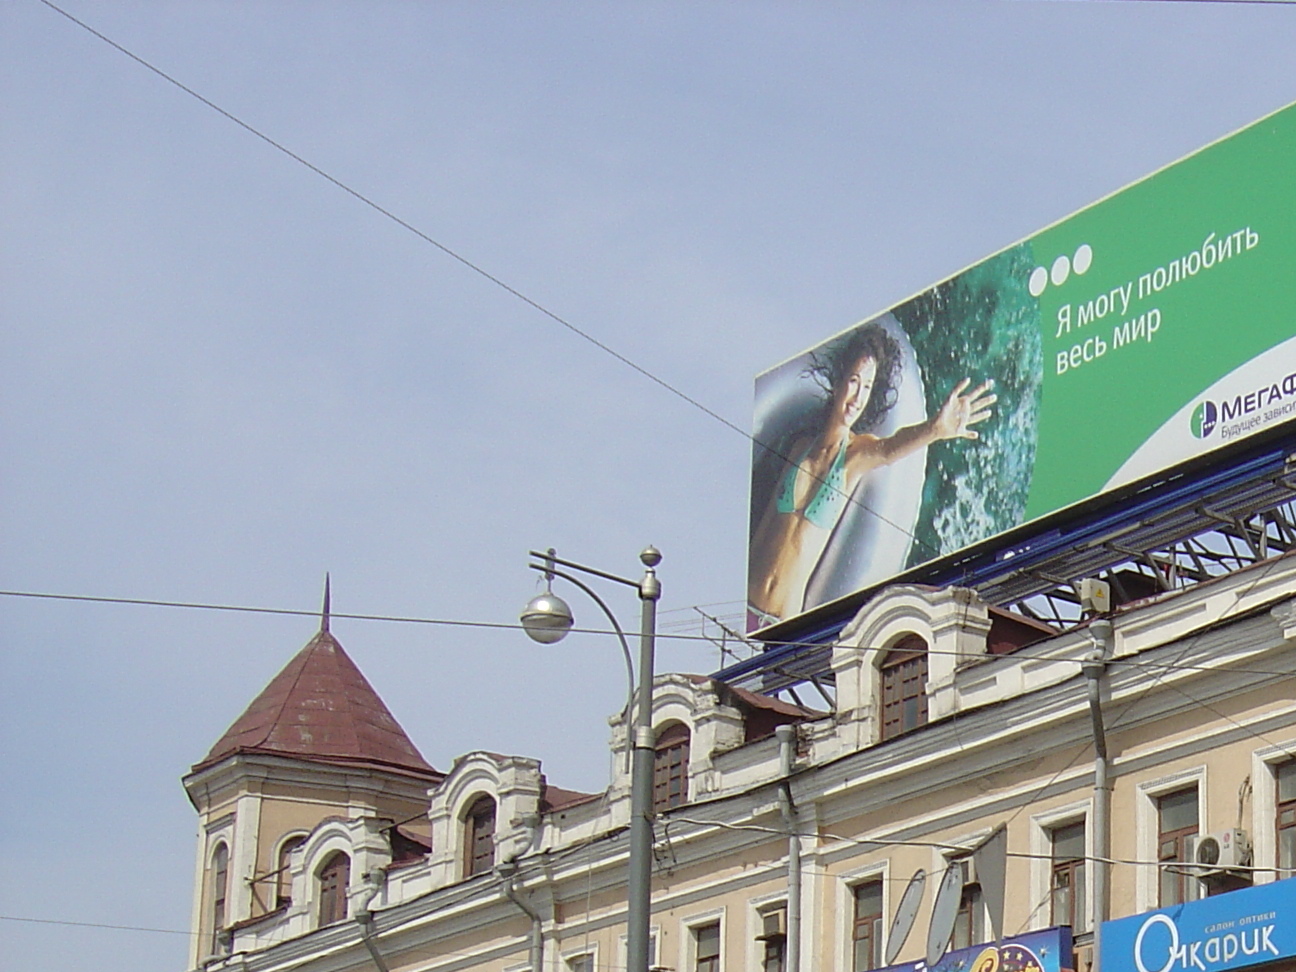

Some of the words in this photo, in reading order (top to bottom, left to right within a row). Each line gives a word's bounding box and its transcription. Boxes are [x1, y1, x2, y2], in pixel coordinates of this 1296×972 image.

[1056, 305, 1071, 338] Я
[1077, 282, 1134, 329] могу
[1138, 226, 1260, 300] полюбить
[1056, 336, 1108, 375] весь
[1113, 308, 1162, 350] мир
[1204, 919, 1236, 934] салон
[1239, 910, 1277, 927] оптики
